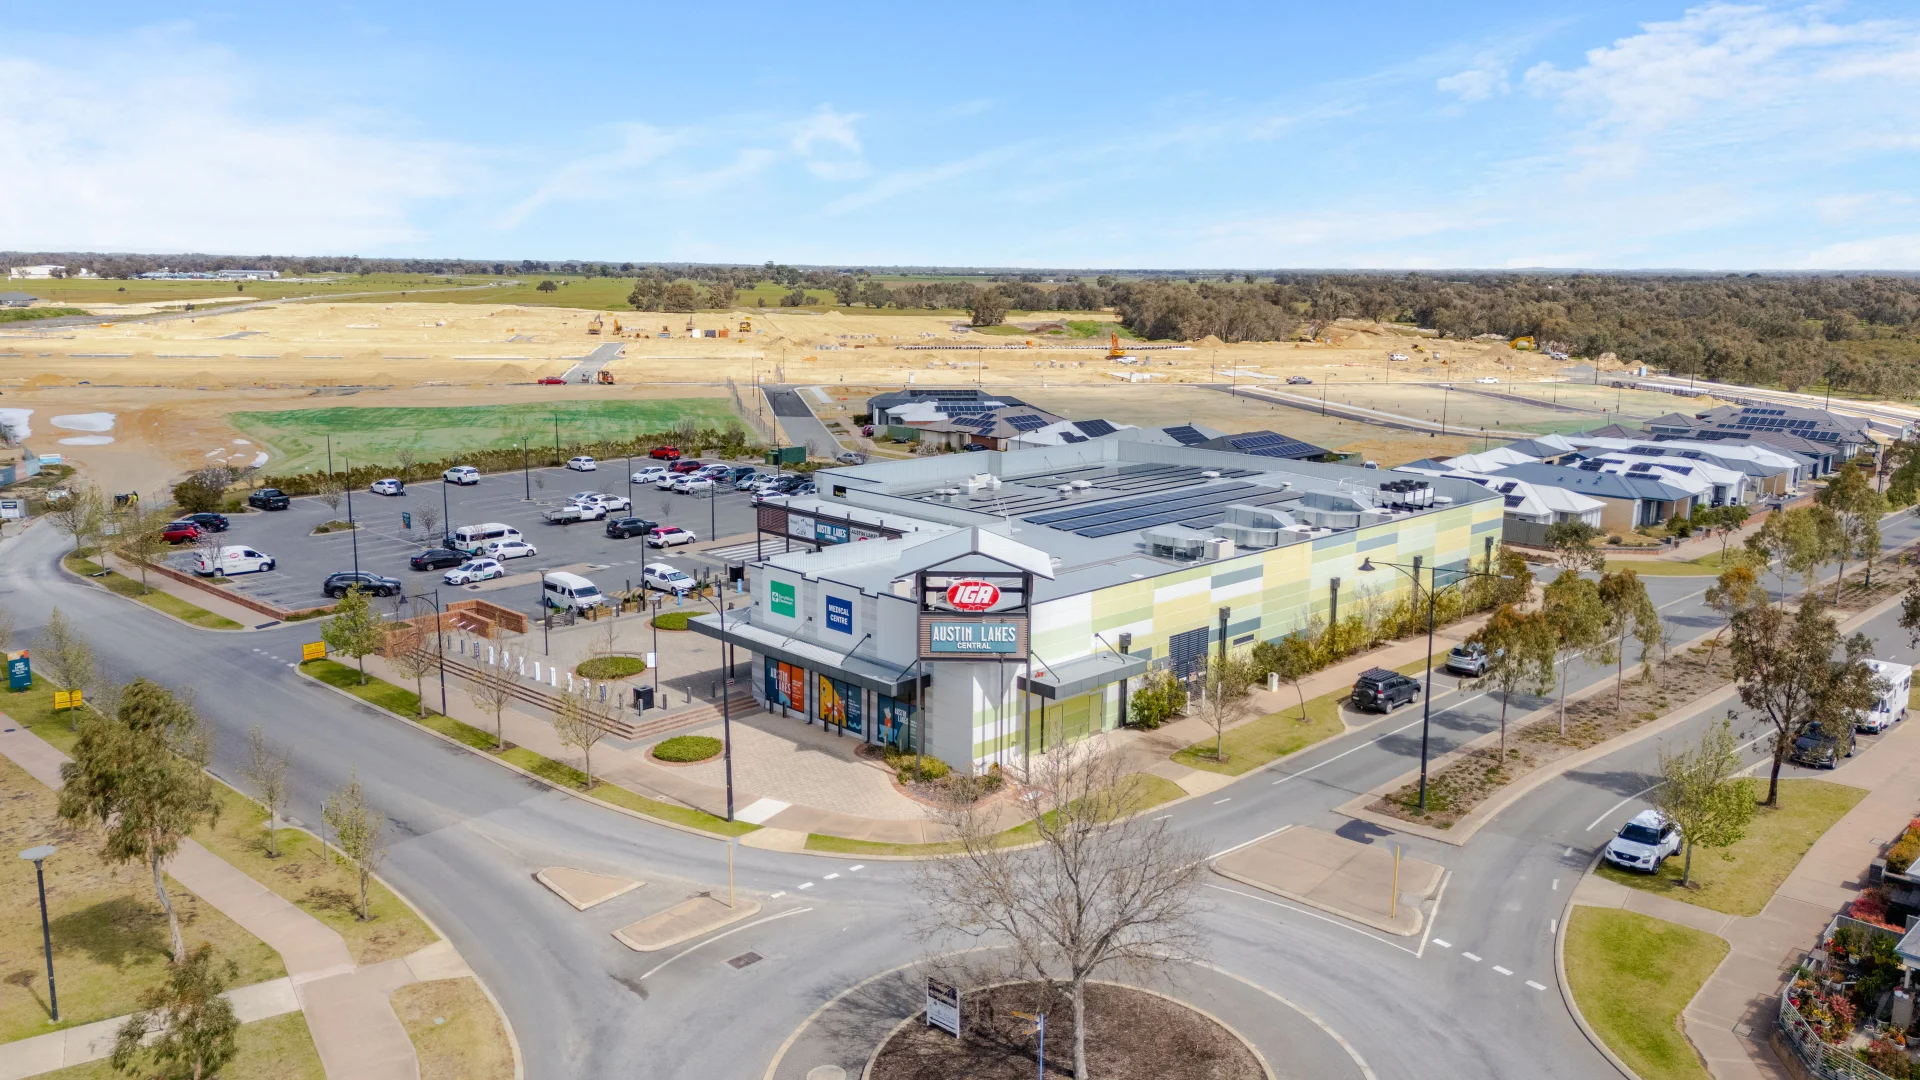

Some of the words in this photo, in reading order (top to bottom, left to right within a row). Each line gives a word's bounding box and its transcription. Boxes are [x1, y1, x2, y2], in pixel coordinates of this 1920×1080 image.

[953, 586, 994, 604] IGA
[828, 604, 850, 617] MEDICAL
[829, 614, 849, 626] CENTRE
[933, 626, 973, 642] AUSTIN
[981, 626, 1016, 642] LAKES
[957, 642, 992, 650] CENTRAL
